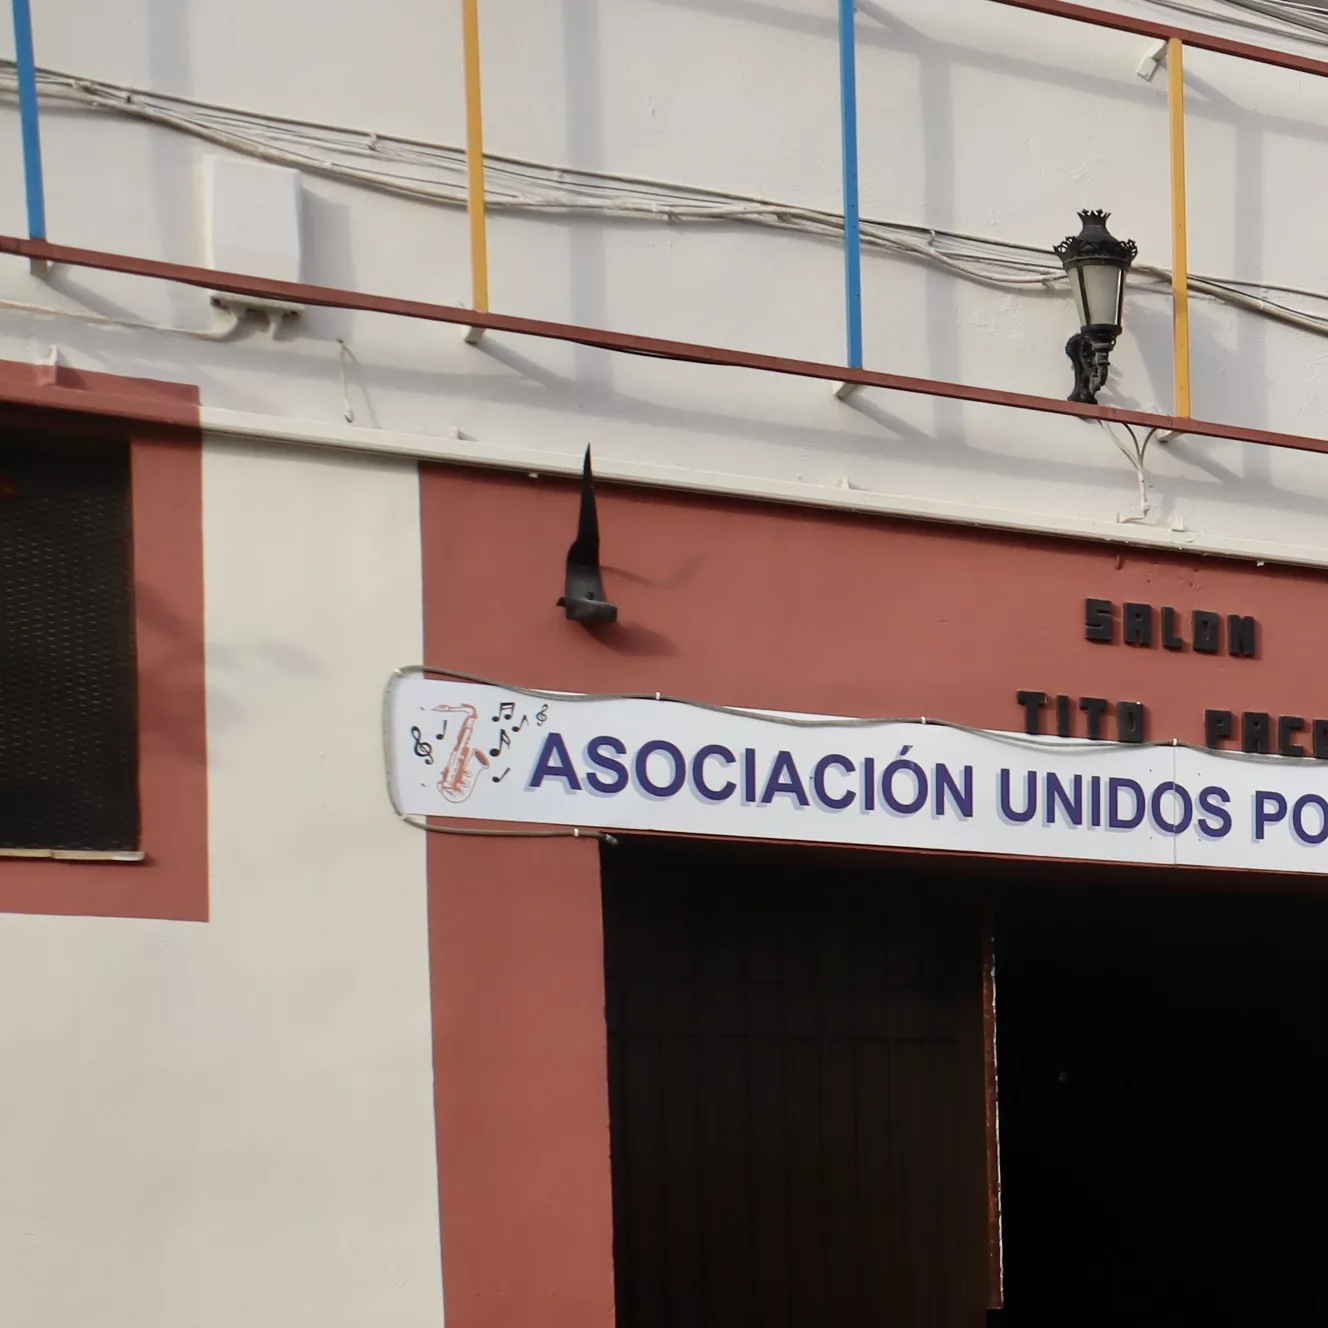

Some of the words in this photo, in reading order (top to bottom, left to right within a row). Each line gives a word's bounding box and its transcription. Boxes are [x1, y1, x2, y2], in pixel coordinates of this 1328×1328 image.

[1085, 597, 1256, 658] SALON
[1016, 689, 1144, 743] TITO
[529, 731, 974, 819] ASOCIACIÓN
[1000, 768, 1233, 839] UNIDOS
